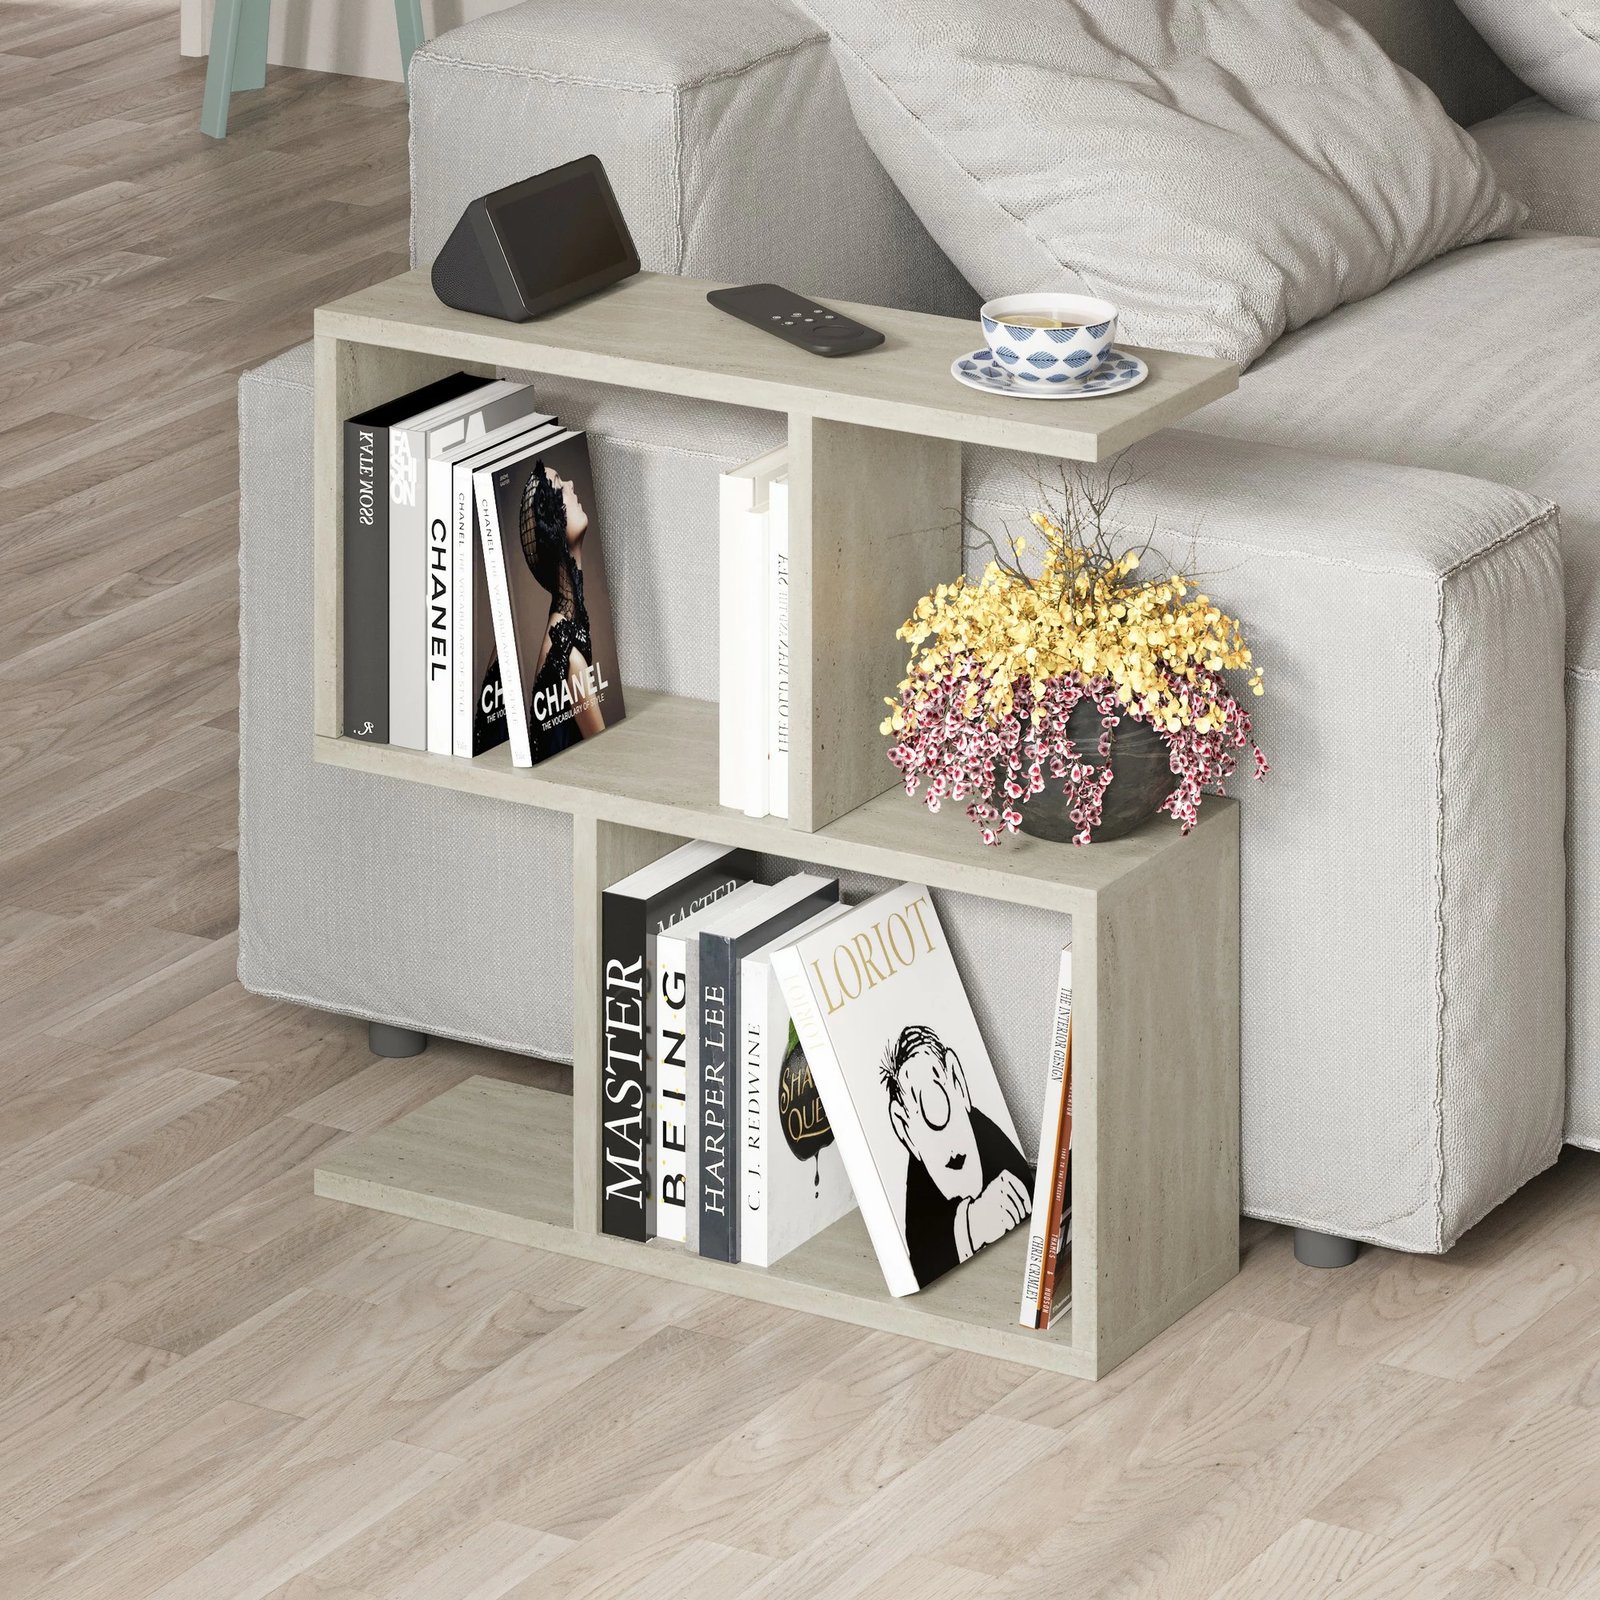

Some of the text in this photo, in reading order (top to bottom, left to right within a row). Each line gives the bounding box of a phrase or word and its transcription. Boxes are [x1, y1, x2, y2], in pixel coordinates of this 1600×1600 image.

[481, 498, 495, 555] CHANEL
[431, 518, 448, 682] CHANEL
[533, 662, 609, 721] CHANEL
[541, 721, 552, 731] THE
[551, 705, 583, 728] VOCABULARY
[810, 896, 936, 1015] LORIOT
[1060, 987, 1073, 1006] THE
[1054, 1006, 1071, 1048] INTERIOR
[606, 955, 644, 1209] MASTER
[662, 970, 687, 1208] BEING
[704, 984, 726, 1217] HARPER LEE
[748, 1023, 761, 1149] REDWINE
[748, 1188, 761, 1211] C.
[1030, 1235, 1044, 1262] CHRIS
[1049, 1233, 1058, 1259] THAMES
[1042, 1287, 1052, 1314] HUDSON
